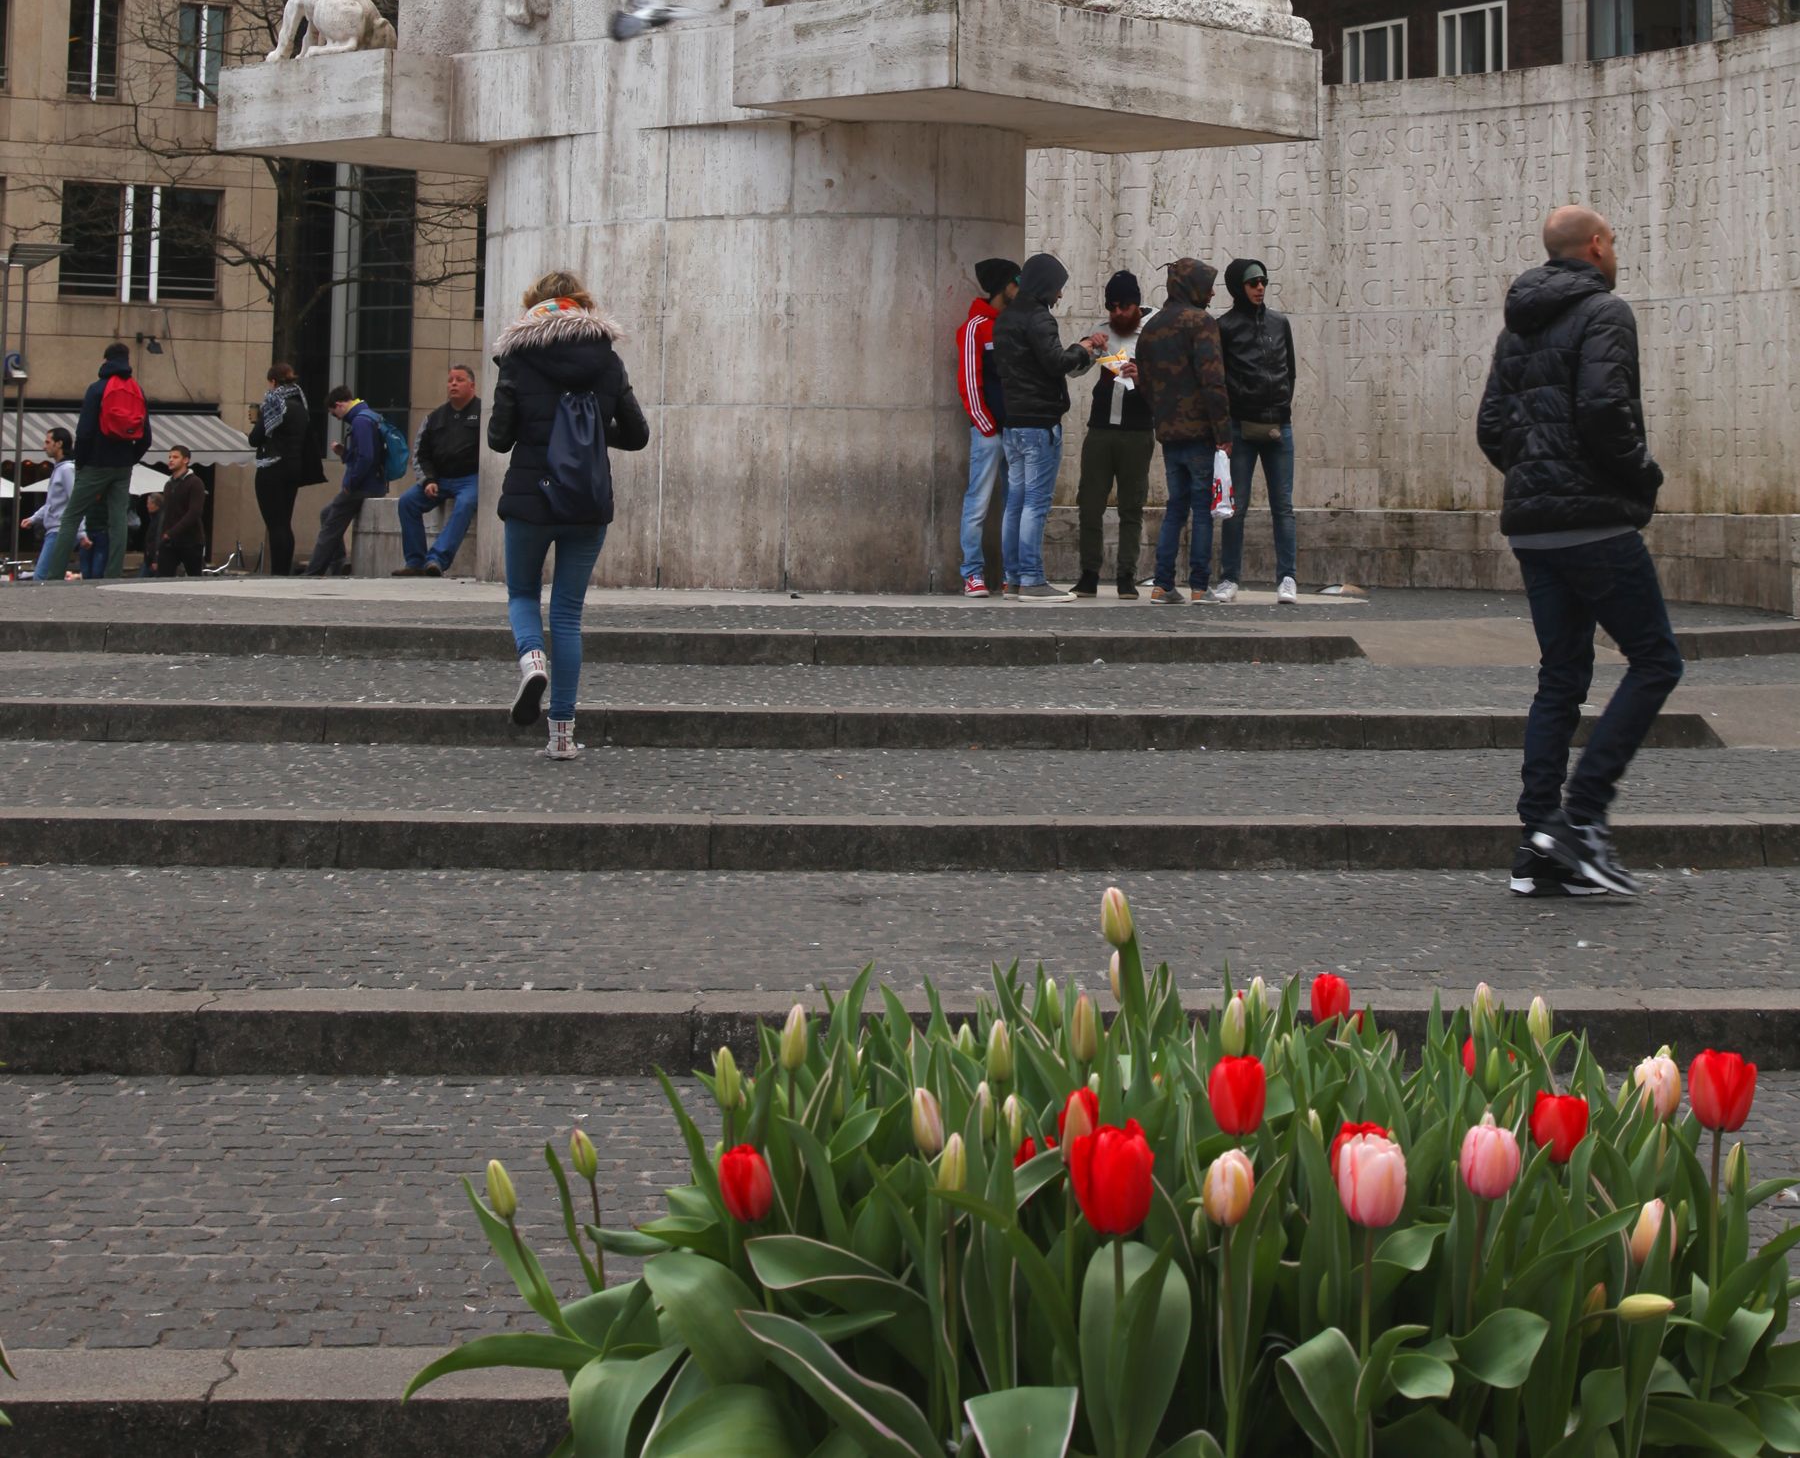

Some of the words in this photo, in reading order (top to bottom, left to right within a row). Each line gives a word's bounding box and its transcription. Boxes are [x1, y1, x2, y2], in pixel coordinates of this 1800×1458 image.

[1401, 157, 1487, 193] BRAK
[1502, 151, 1571, 187] WET
[1156, 206, 1330, 240] DAALDEN
[1348, 203, 1393, 233] DE
[1263, 244, 1310, 274] DE
[1328, 240, 1404, 270] WET
[1417, 232, 1538, 266] TERUG
